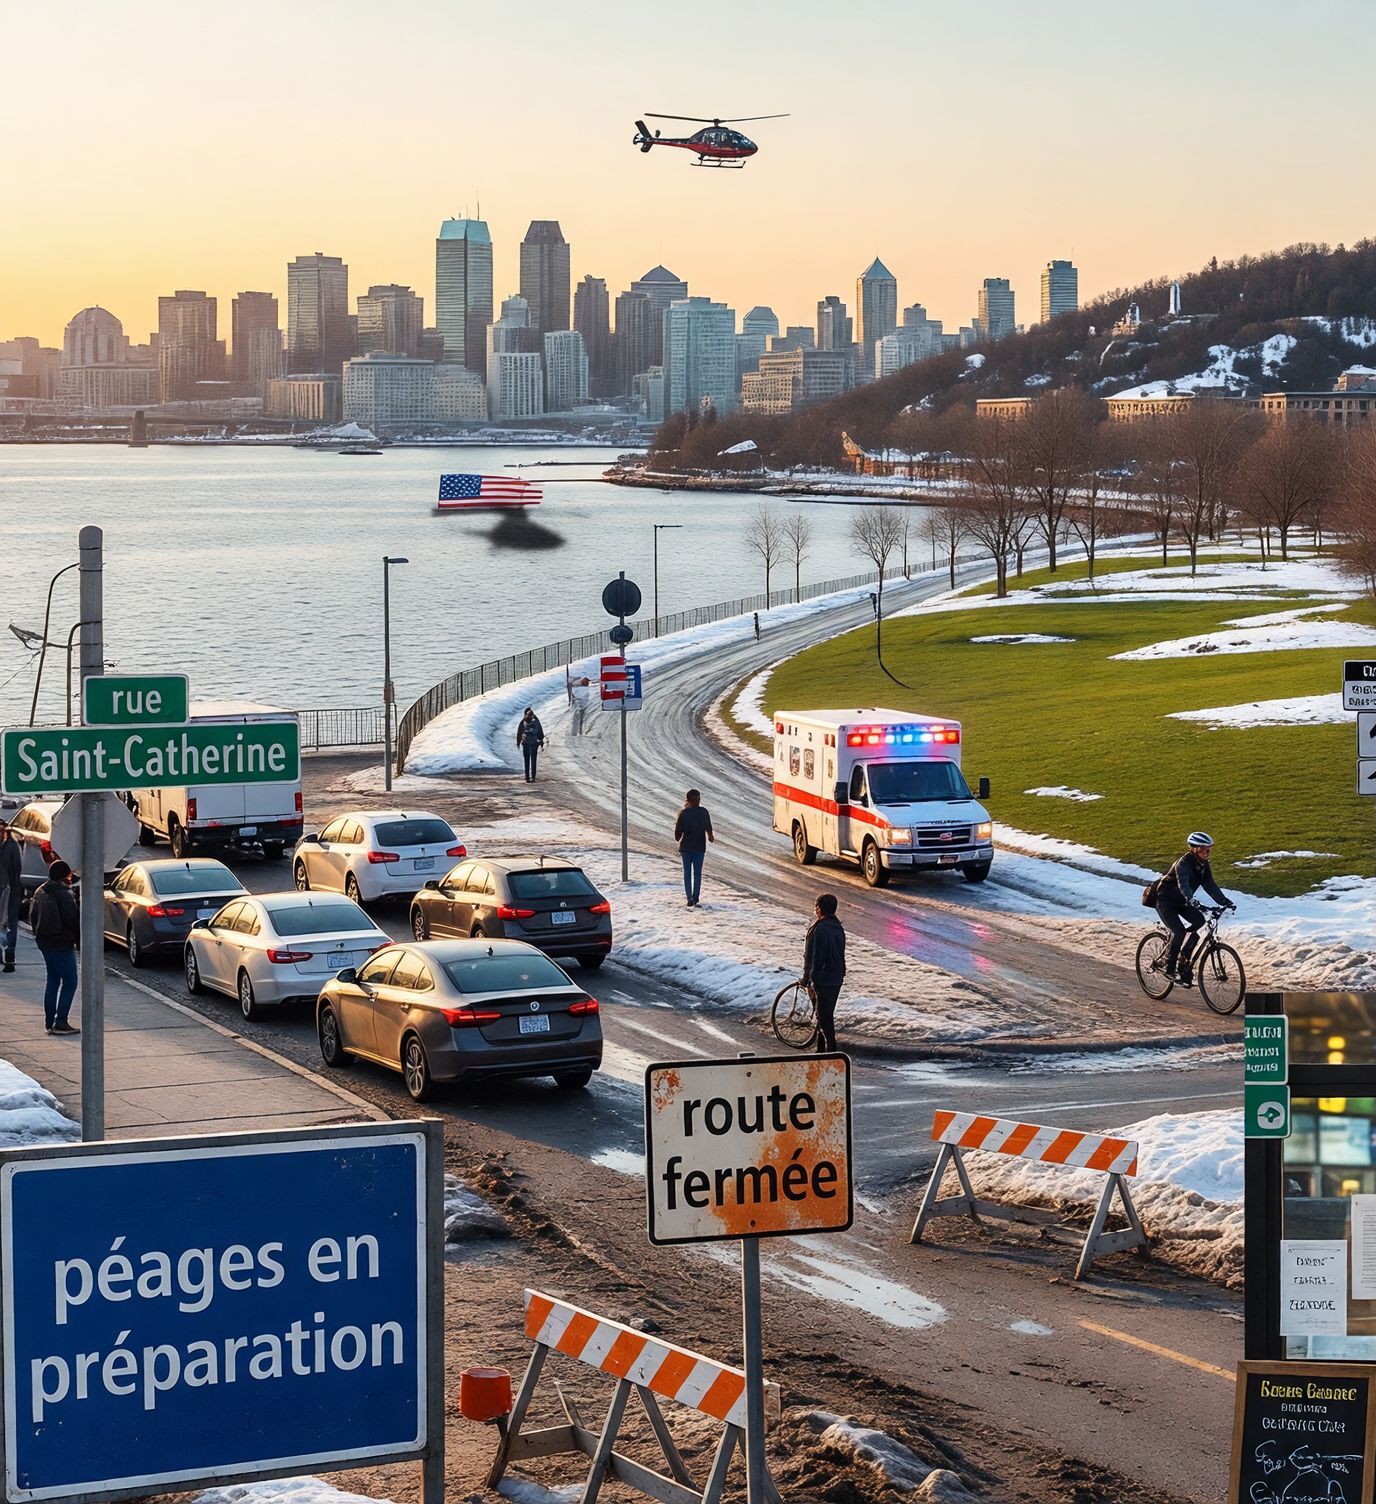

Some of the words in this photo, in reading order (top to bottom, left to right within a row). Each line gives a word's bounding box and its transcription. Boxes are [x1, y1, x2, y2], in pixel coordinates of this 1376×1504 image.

[112, 690, 162, 714] rue
[18, 733, 287, 782] Saint-Catherine
[683, 1084, 816, 1137] route
[662, 1147, 838, 1211] fermée
[55, 1236, 285, 1325] péages
[308, 1234, 380, 1283] en
[31, 1311, 404, 1423] préparation
